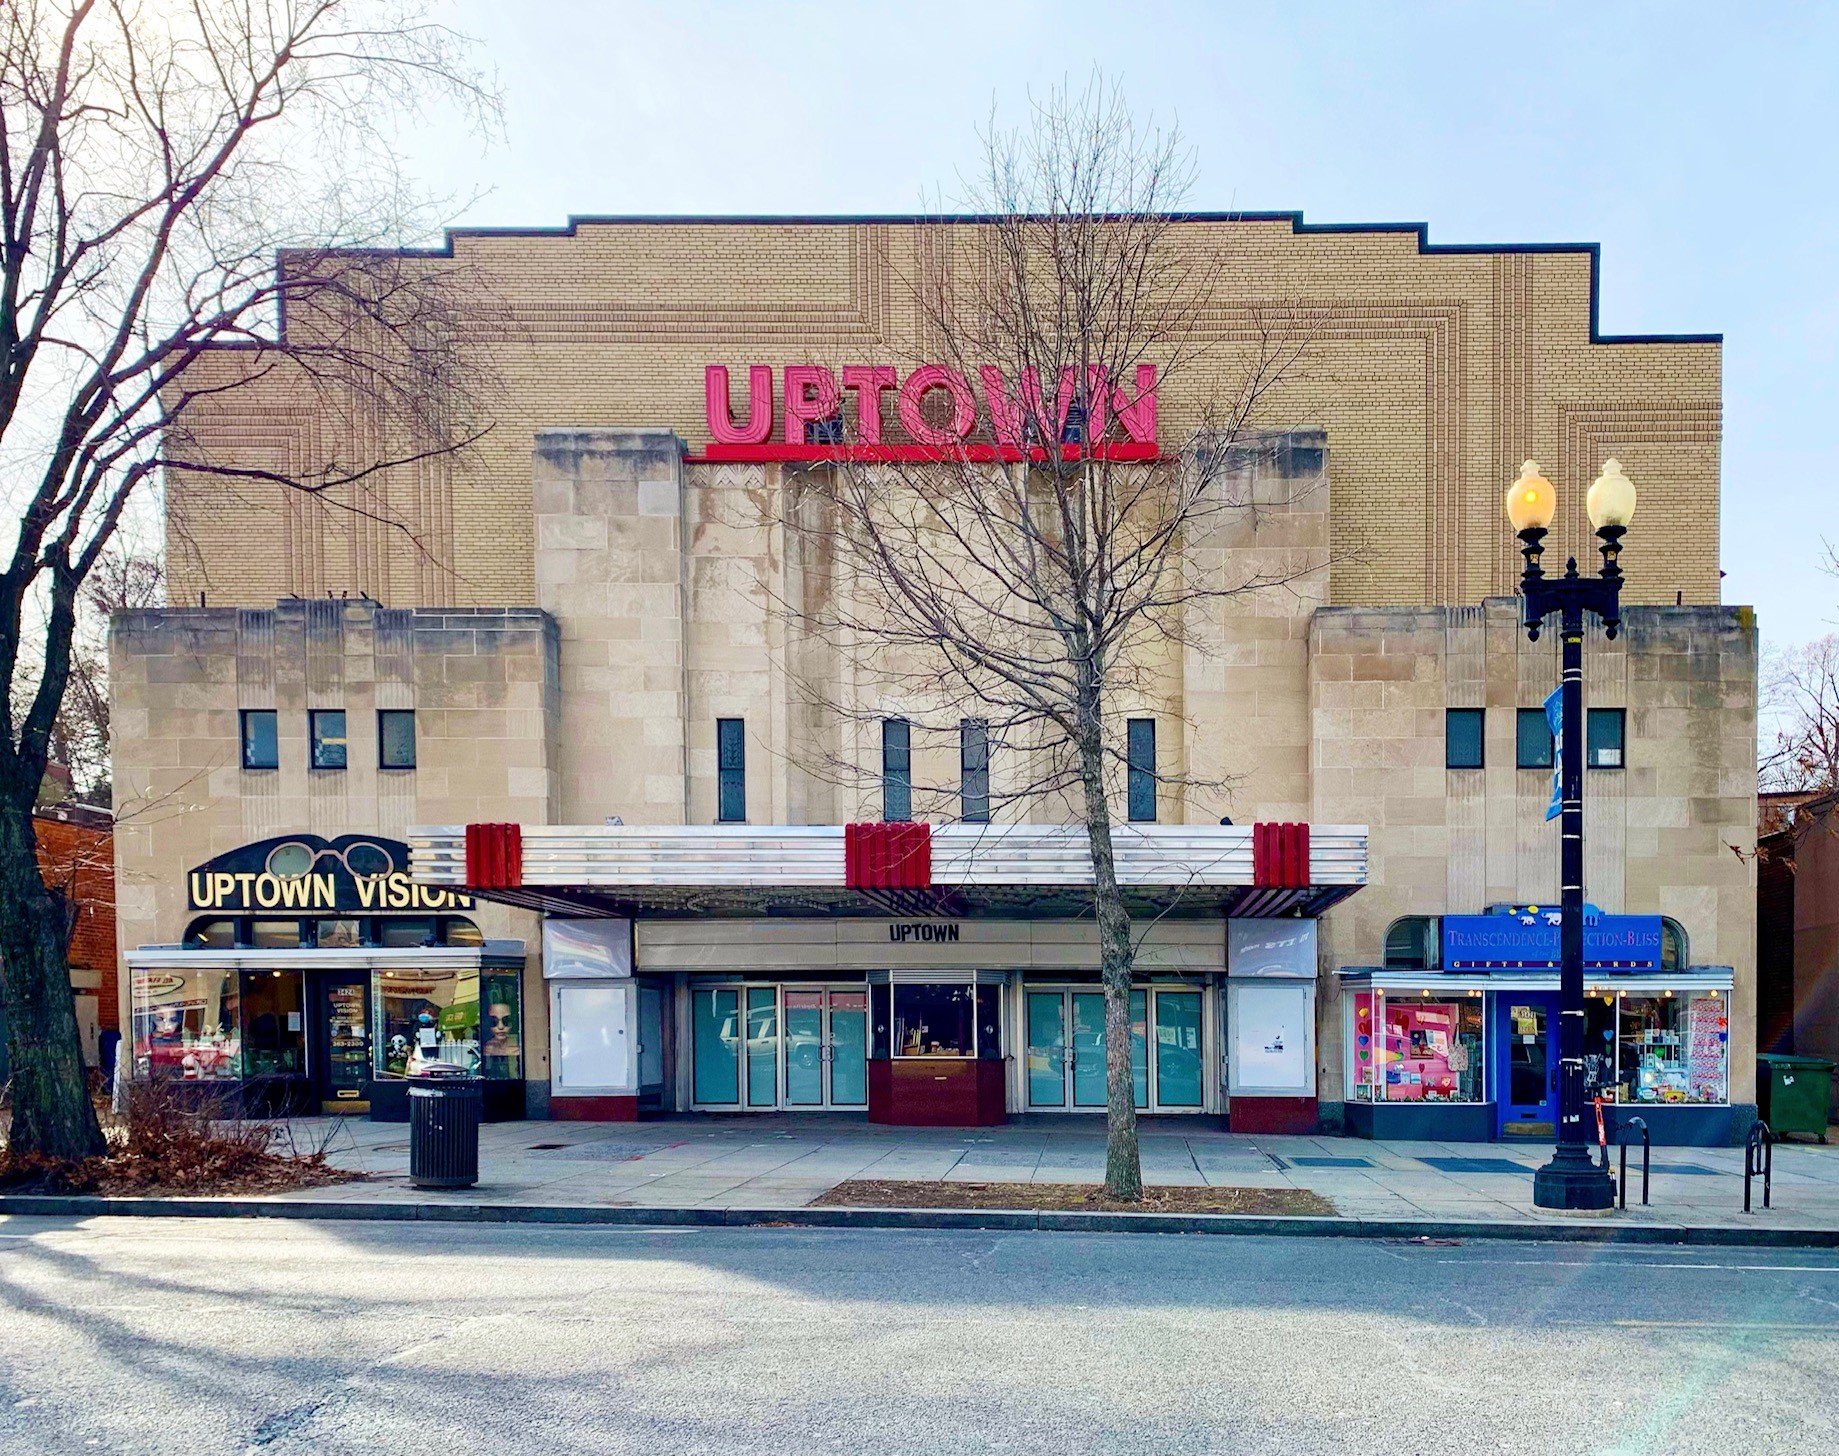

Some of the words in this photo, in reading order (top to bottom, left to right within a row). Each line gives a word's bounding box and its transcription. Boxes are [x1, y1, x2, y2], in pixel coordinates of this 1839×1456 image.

[704, 365, 1158, 444] UPTOWN
[191, 872, 335, 908] UPTOWN
[889, 924, 959, 941] UPTOWN
